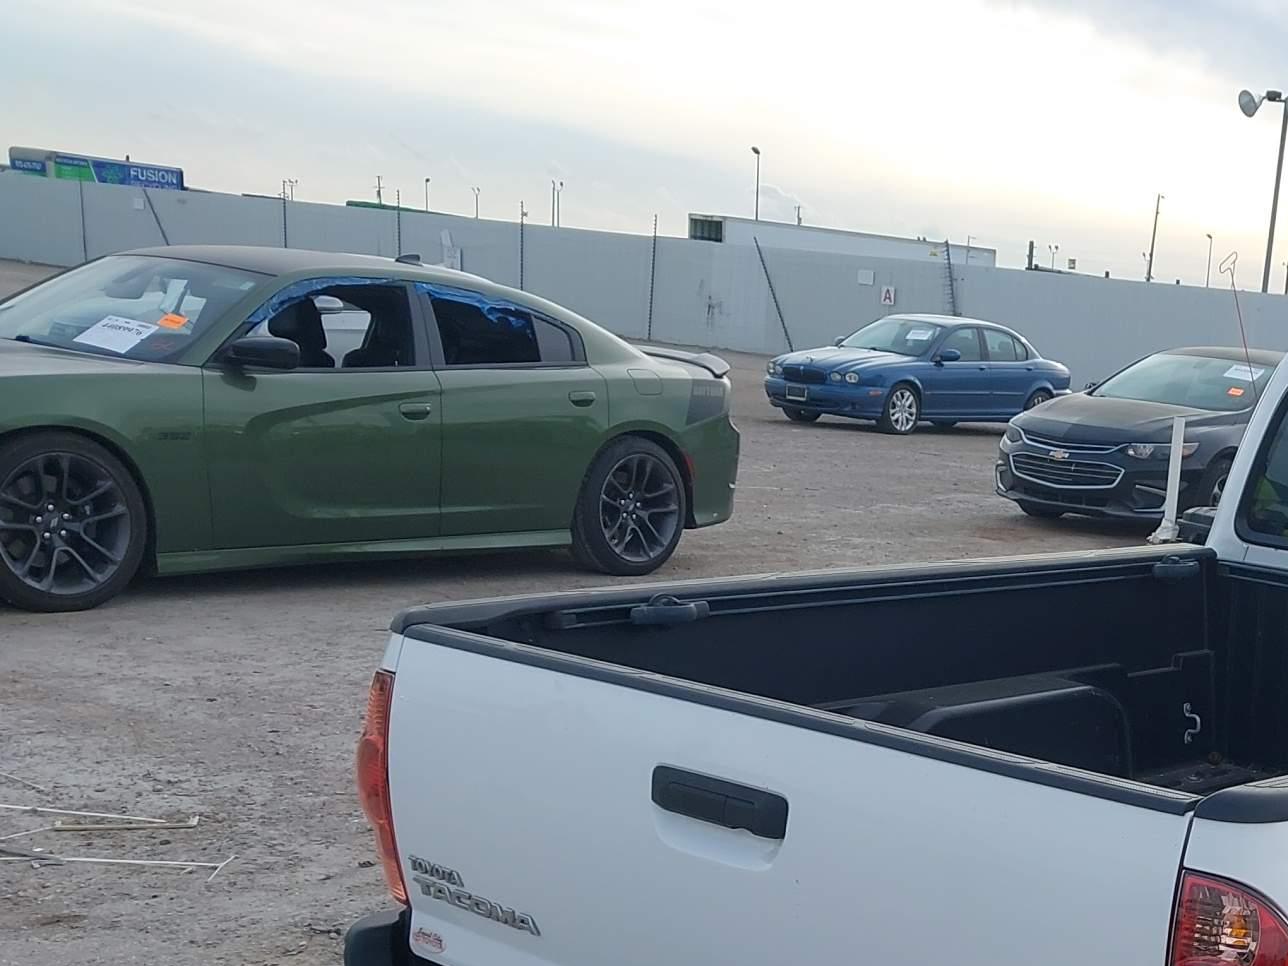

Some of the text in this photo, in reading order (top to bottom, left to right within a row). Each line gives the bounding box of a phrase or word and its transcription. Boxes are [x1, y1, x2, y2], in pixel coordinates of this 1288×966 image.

[129, 167, 178, 185] FUSION
[883, 288, 893, 303] A
[407, 854, 465, 887] TOYOTA
[412, 875, 542, 936] TACOMA
